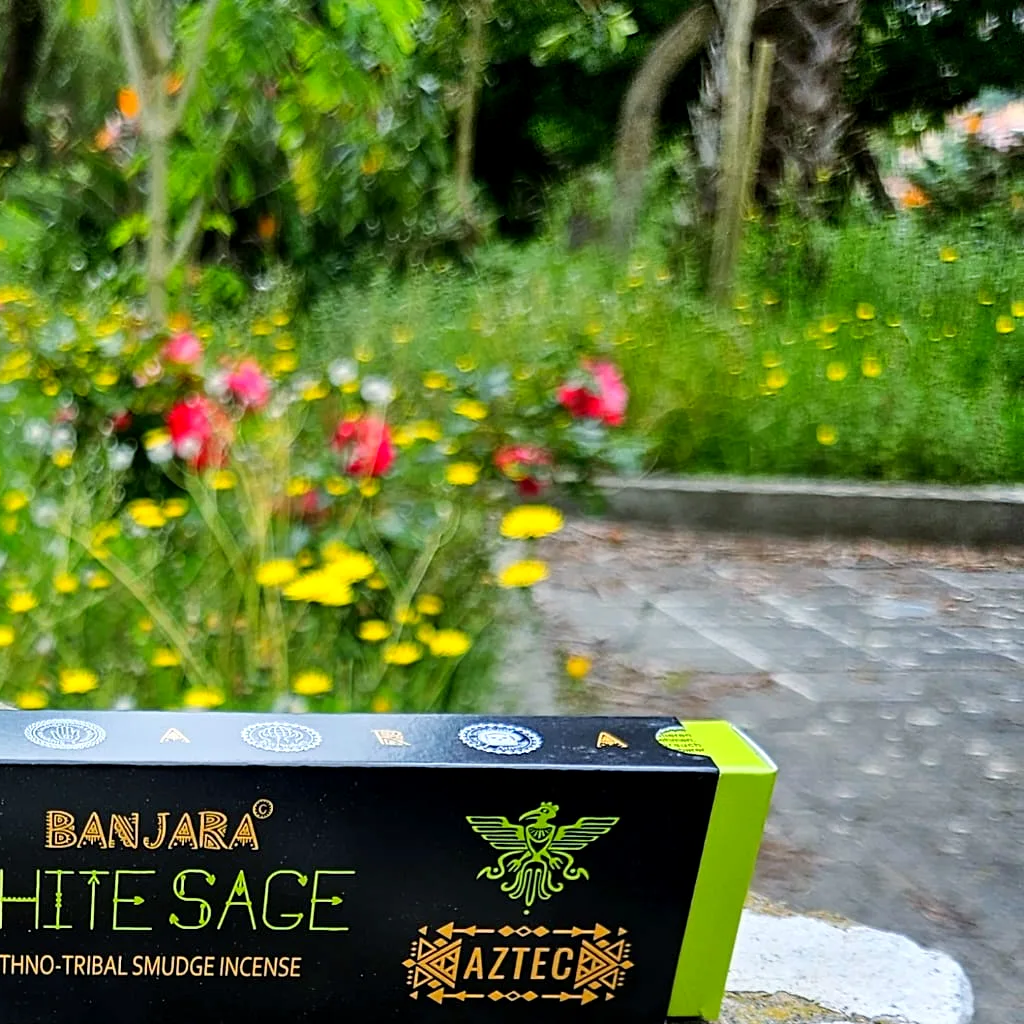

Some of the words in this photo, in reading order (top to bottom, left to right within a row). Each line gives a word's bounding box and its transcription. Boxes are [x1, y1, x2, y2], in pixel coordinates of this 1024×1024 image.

[169, 868, 356, 931] SAGE
[132, 954, 215, 977] SMUDGE
[219, 955, 302, 978] INCENSE
[463, 946, 574, 980] AZTEC
